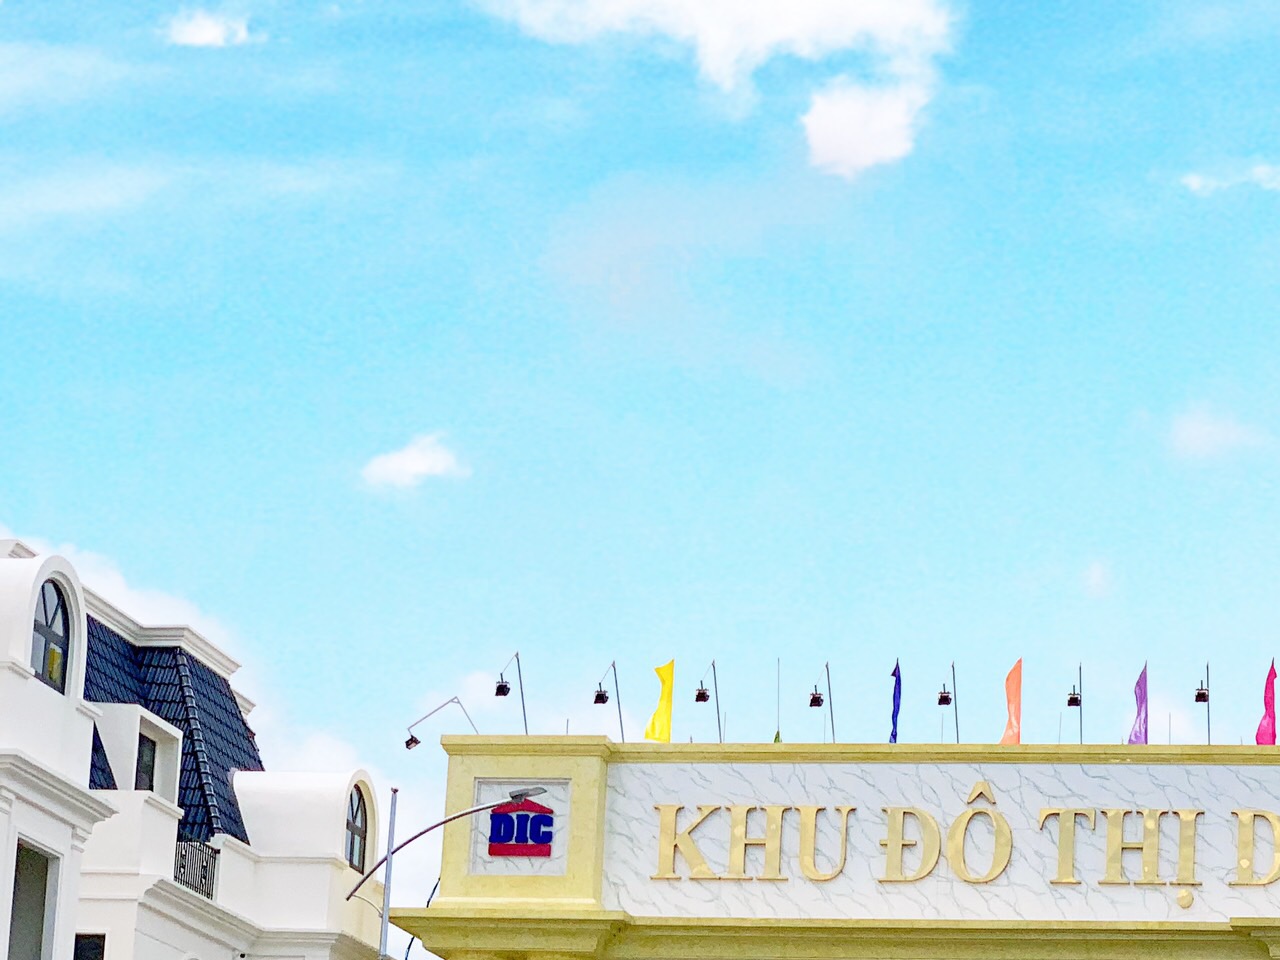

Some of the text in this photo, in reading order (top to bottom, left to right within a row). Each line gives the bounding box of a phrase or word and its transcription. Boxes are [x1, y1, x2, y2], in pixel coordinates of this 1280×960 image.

[489, 813, 553, 844] DIC
[650, 804, 857, 882] KHU
[877, 781, 1014, 885] ĐÔ
[1039, 808, 1204, 910] THỊ
